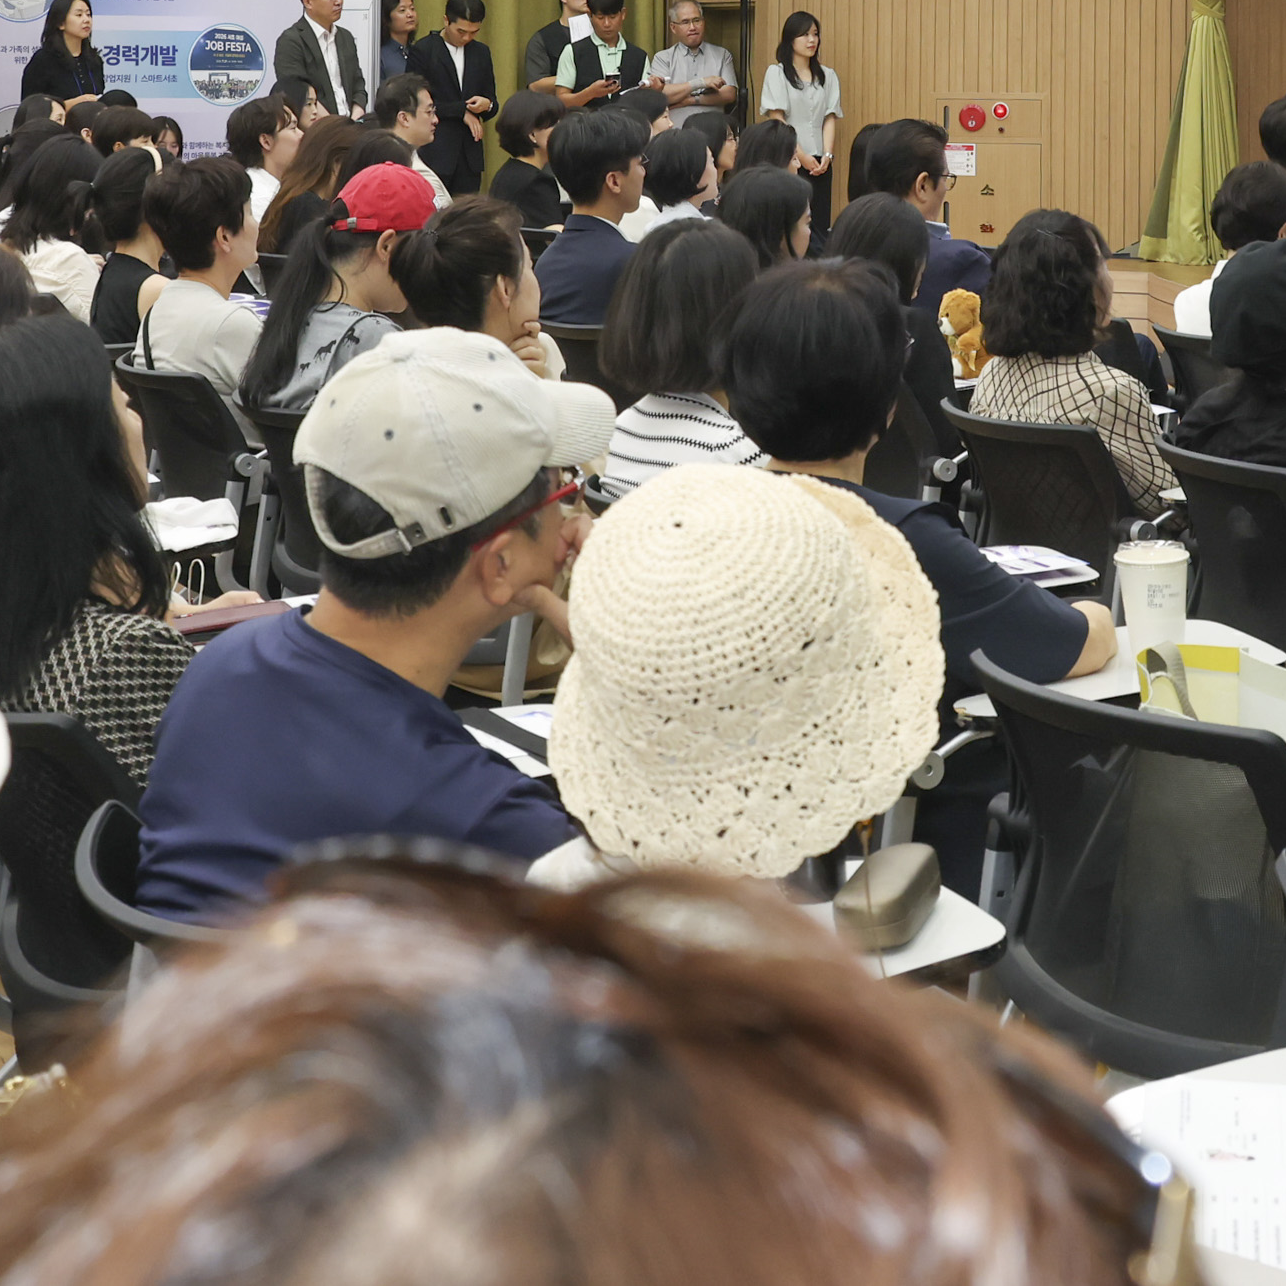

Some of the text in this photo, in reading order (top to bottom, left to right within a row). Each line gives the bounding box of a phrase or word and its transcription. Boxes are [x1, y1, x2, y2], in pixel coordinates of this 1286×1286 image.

[9, 45, 30, 53] 가족의
[205, 40, 252, 52] JOB FESTA
[102, 45, 178, 66] 경력개발
[14, 56, 28, 64] 위한
[141, 75, 178, 83] 스마트서초
